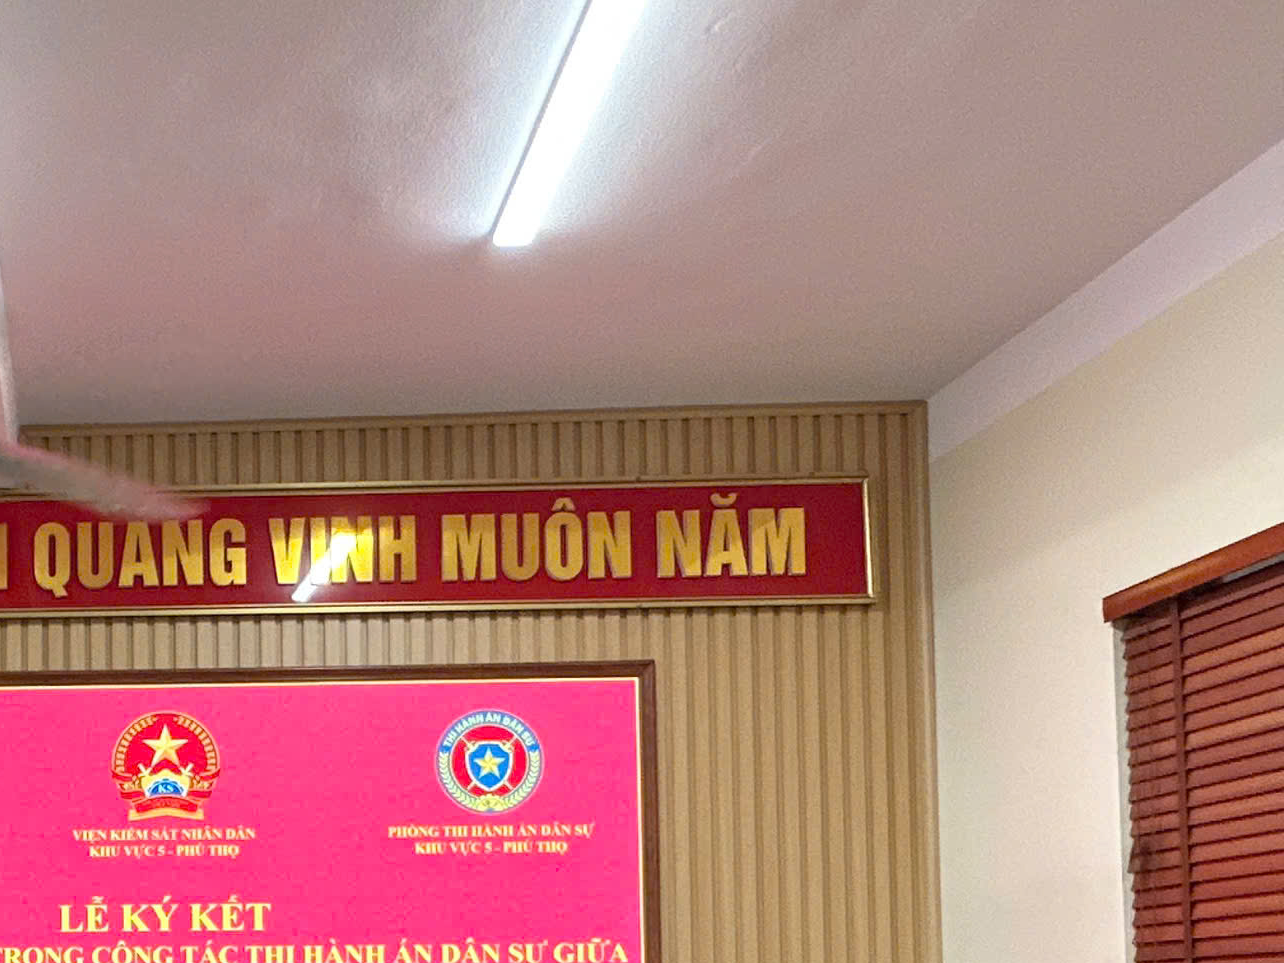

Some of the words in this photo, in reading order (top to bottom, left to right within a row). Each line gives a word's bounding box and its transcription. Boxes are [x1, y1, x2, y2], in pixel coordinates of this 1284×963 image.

[33, 518, 247, 598] QUANG
[268, 515, 416, 584] VINH
[441, 497, 632, 582] MUÔN
[656, 492, 806, 578] NĂM
[443, 825, 467, 838] THI
[89, 845, 121, 858] KHU
[157, 845, 165, 857] 5
[208, 844, 239, 859] THỌ
[415, 842, 446, 855] KHU
[484, 842, 492, 854] 5
[537, 841, 568, 855] THỌ
[59, 896, 109, 932] LỄ
[121, 895, 178, 932] KÝ
[190, 894, 271, 932] KẾT
[441, 937, 500, 963] DÂN
[553, 938, 628, 963] GIỮA
